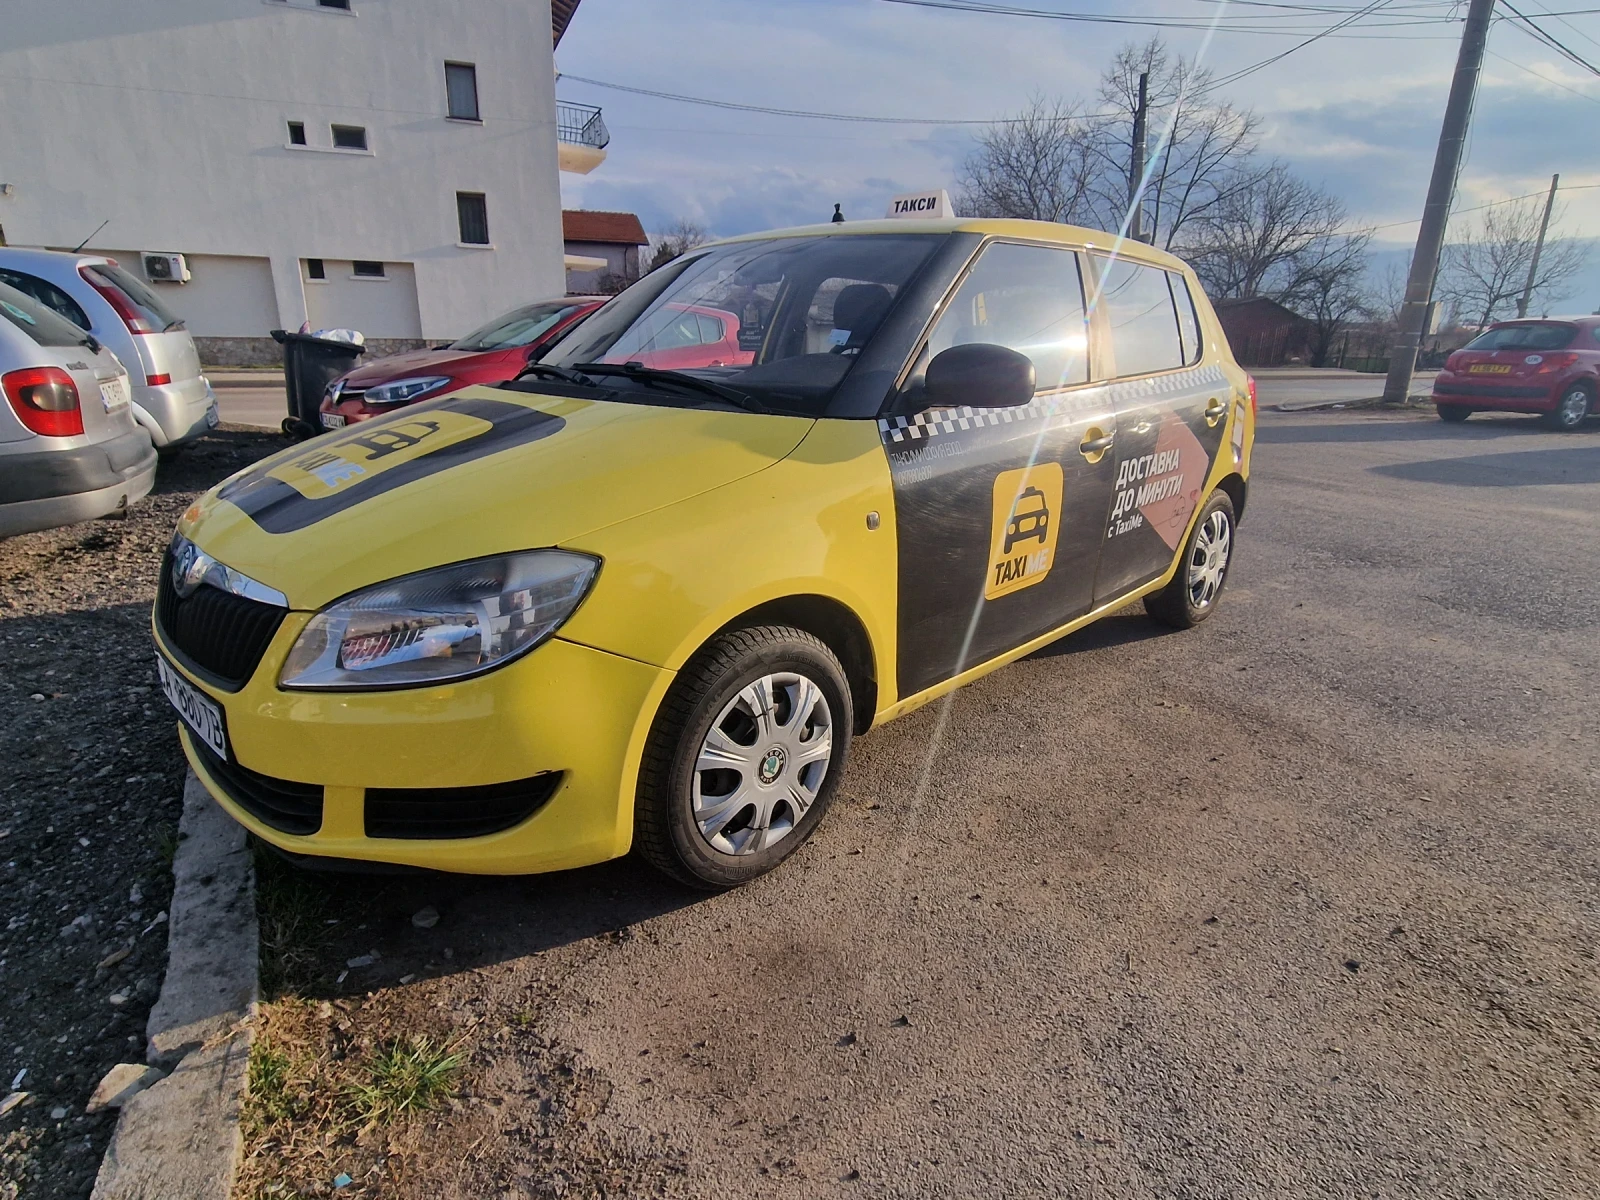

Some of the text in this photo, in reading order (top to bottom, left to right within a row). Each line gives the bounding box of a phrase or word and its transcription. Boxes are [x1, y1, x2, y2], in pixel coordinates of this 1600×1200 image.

[894, 197, 937, 214] ТАКСИ
[1115, 448, 1180, 491] ДОСТАВКА
[1111, 473, 1184, 521] ДО МИНУТИ
[1115, 513, 1143, 536] TaxiMe
